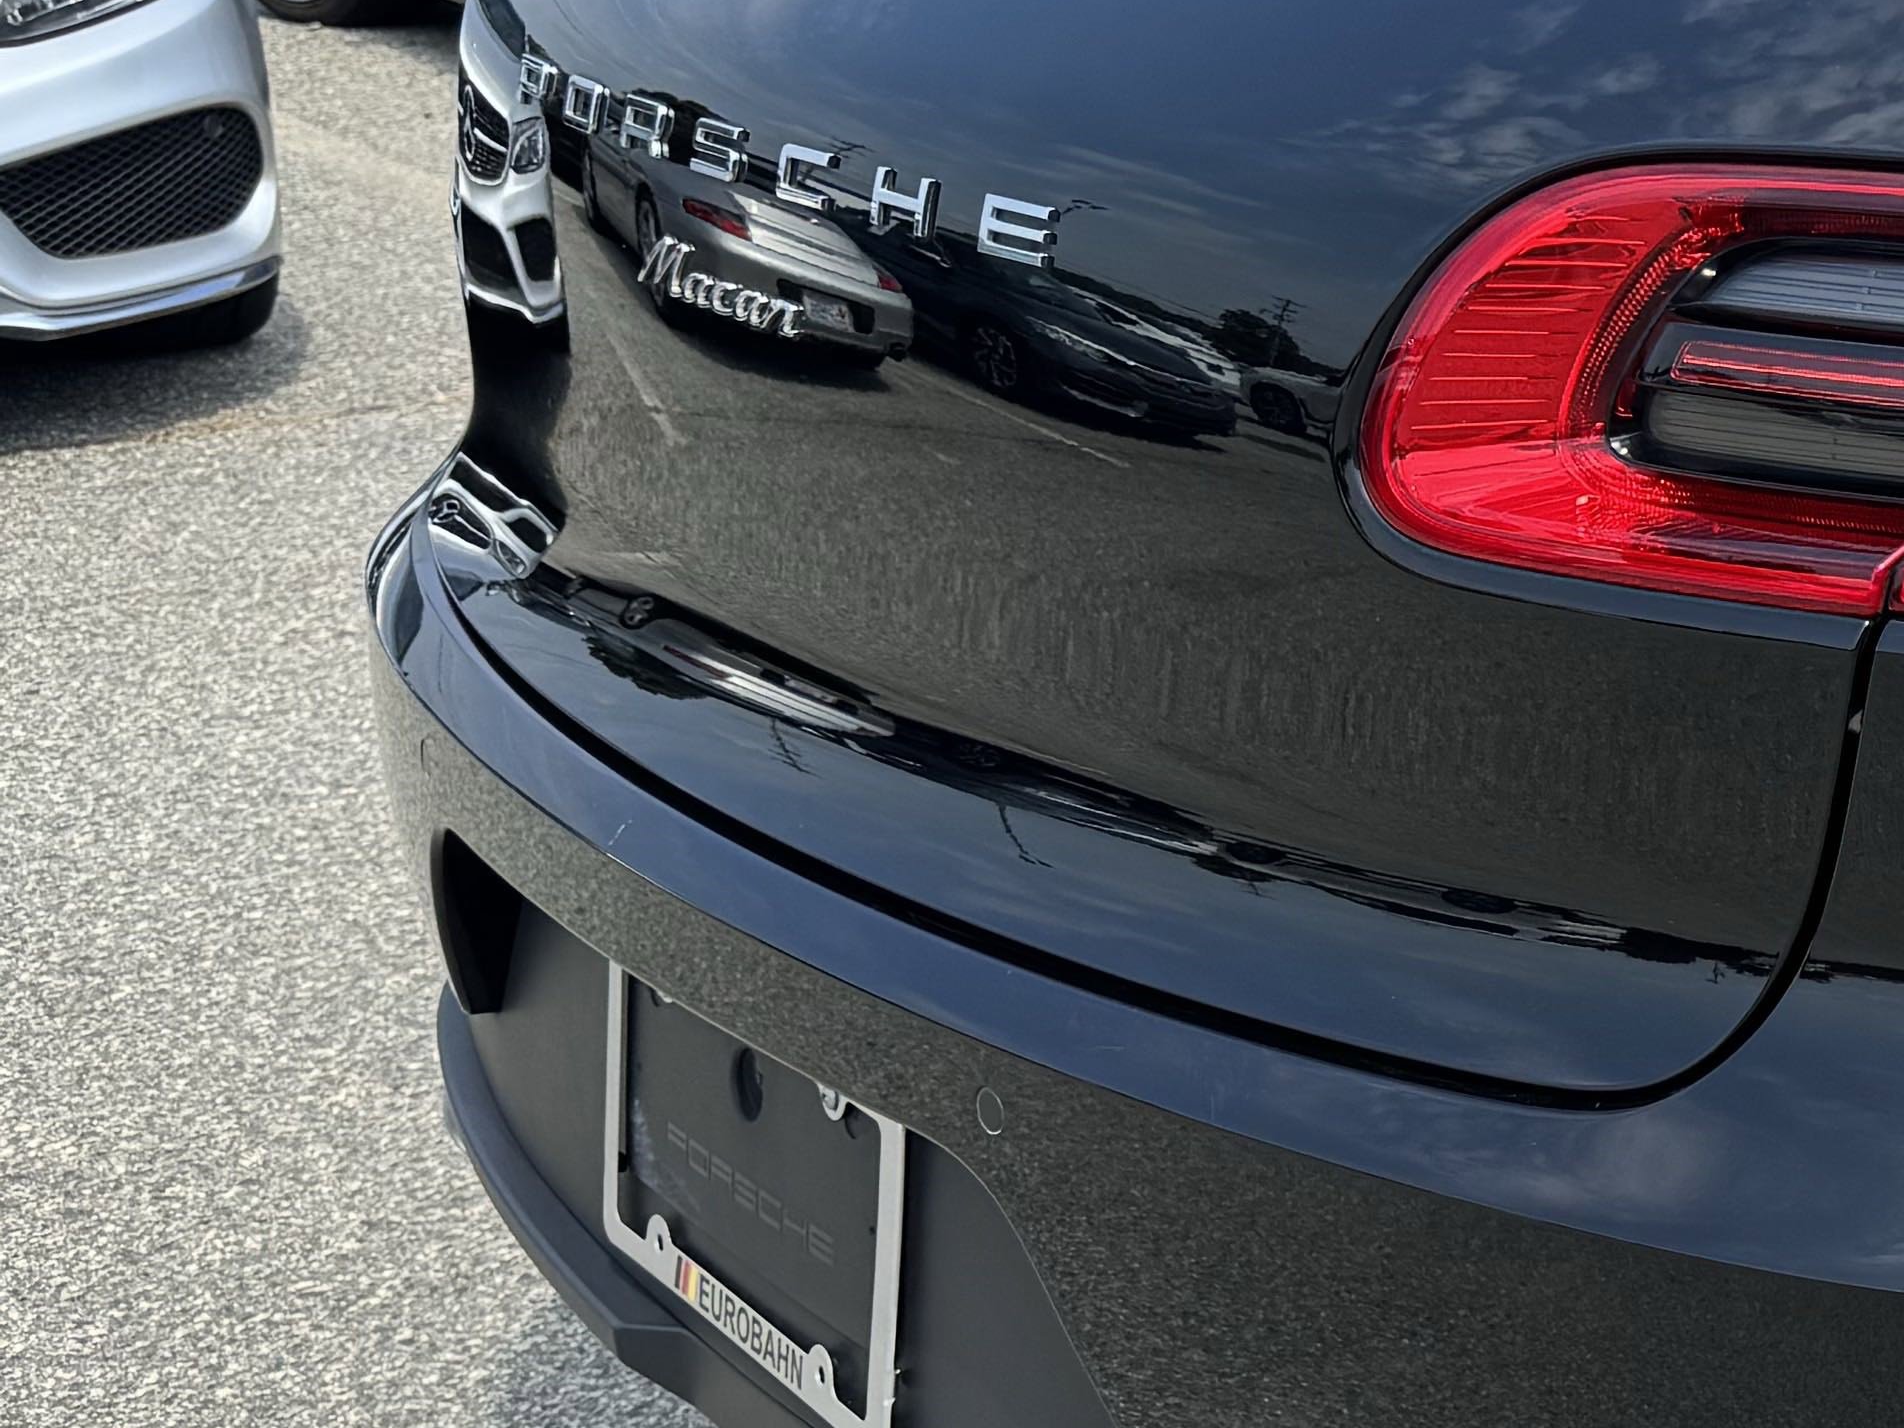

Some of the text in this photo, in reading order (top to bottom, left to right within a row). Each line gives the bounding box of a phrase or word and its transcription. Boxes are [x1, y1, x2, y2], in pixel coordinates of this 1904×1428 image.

[518, 51, 1061, 269] PORSCHE
[637, 233, 804, 339] Macan
[698, 1275, 804, 1392] EUROBAHN
